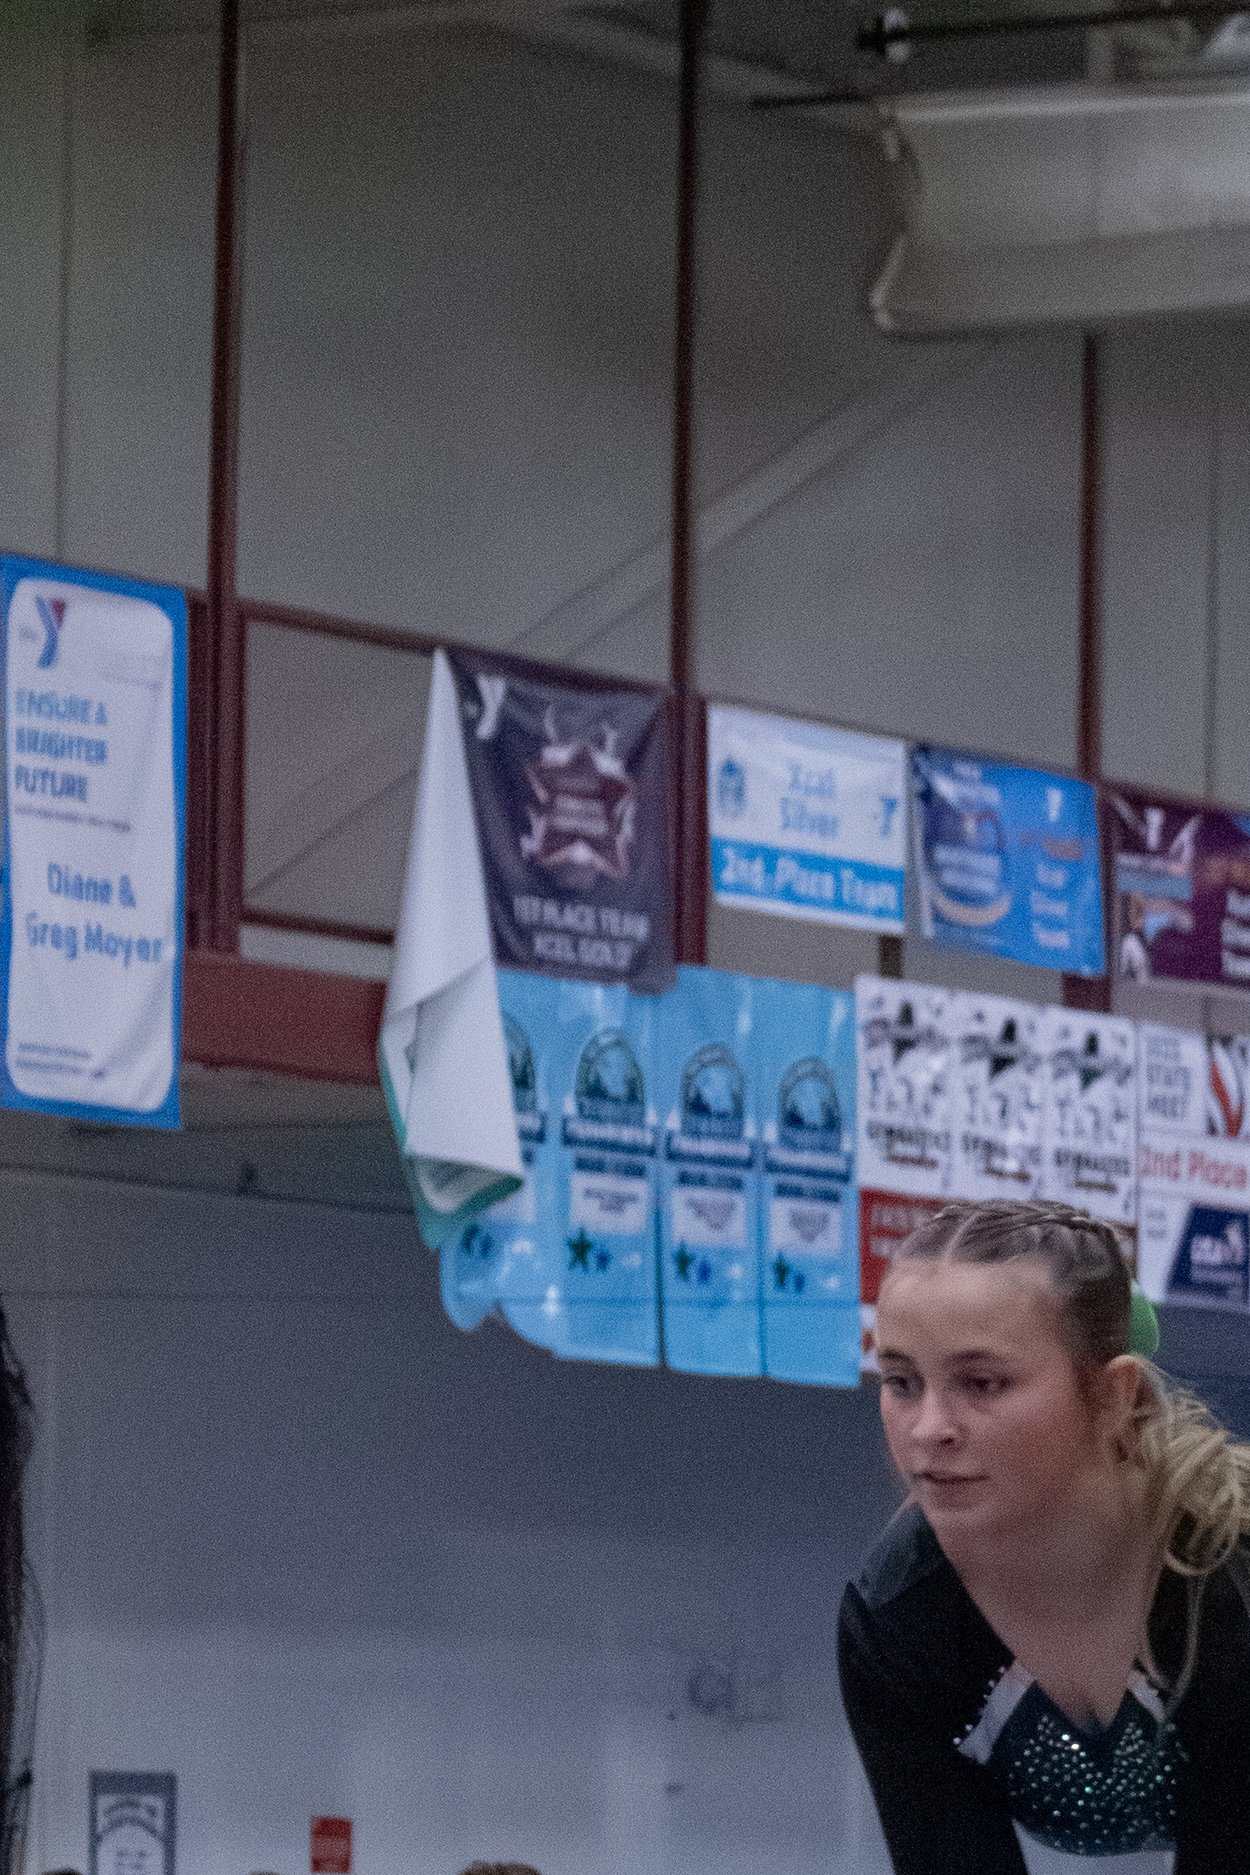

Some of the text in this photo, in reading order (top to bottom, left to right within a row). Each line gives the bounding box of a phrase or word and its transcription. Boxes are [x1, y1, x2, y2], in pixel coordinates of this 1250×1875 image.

[16, 688, 109, 726] ENSURE A
[16, 726, 108, 765] BRIGHTER
[15, 764, 88, 802] FUTURE
[47, 861, 137, 908] Diane &
[721, 847, 765, 892] 2nd
[774, 855, 836, 902] Place
[26, 910, 80, 962] Greg
[1138, 1145, 1248, 1191] 2nd Place
